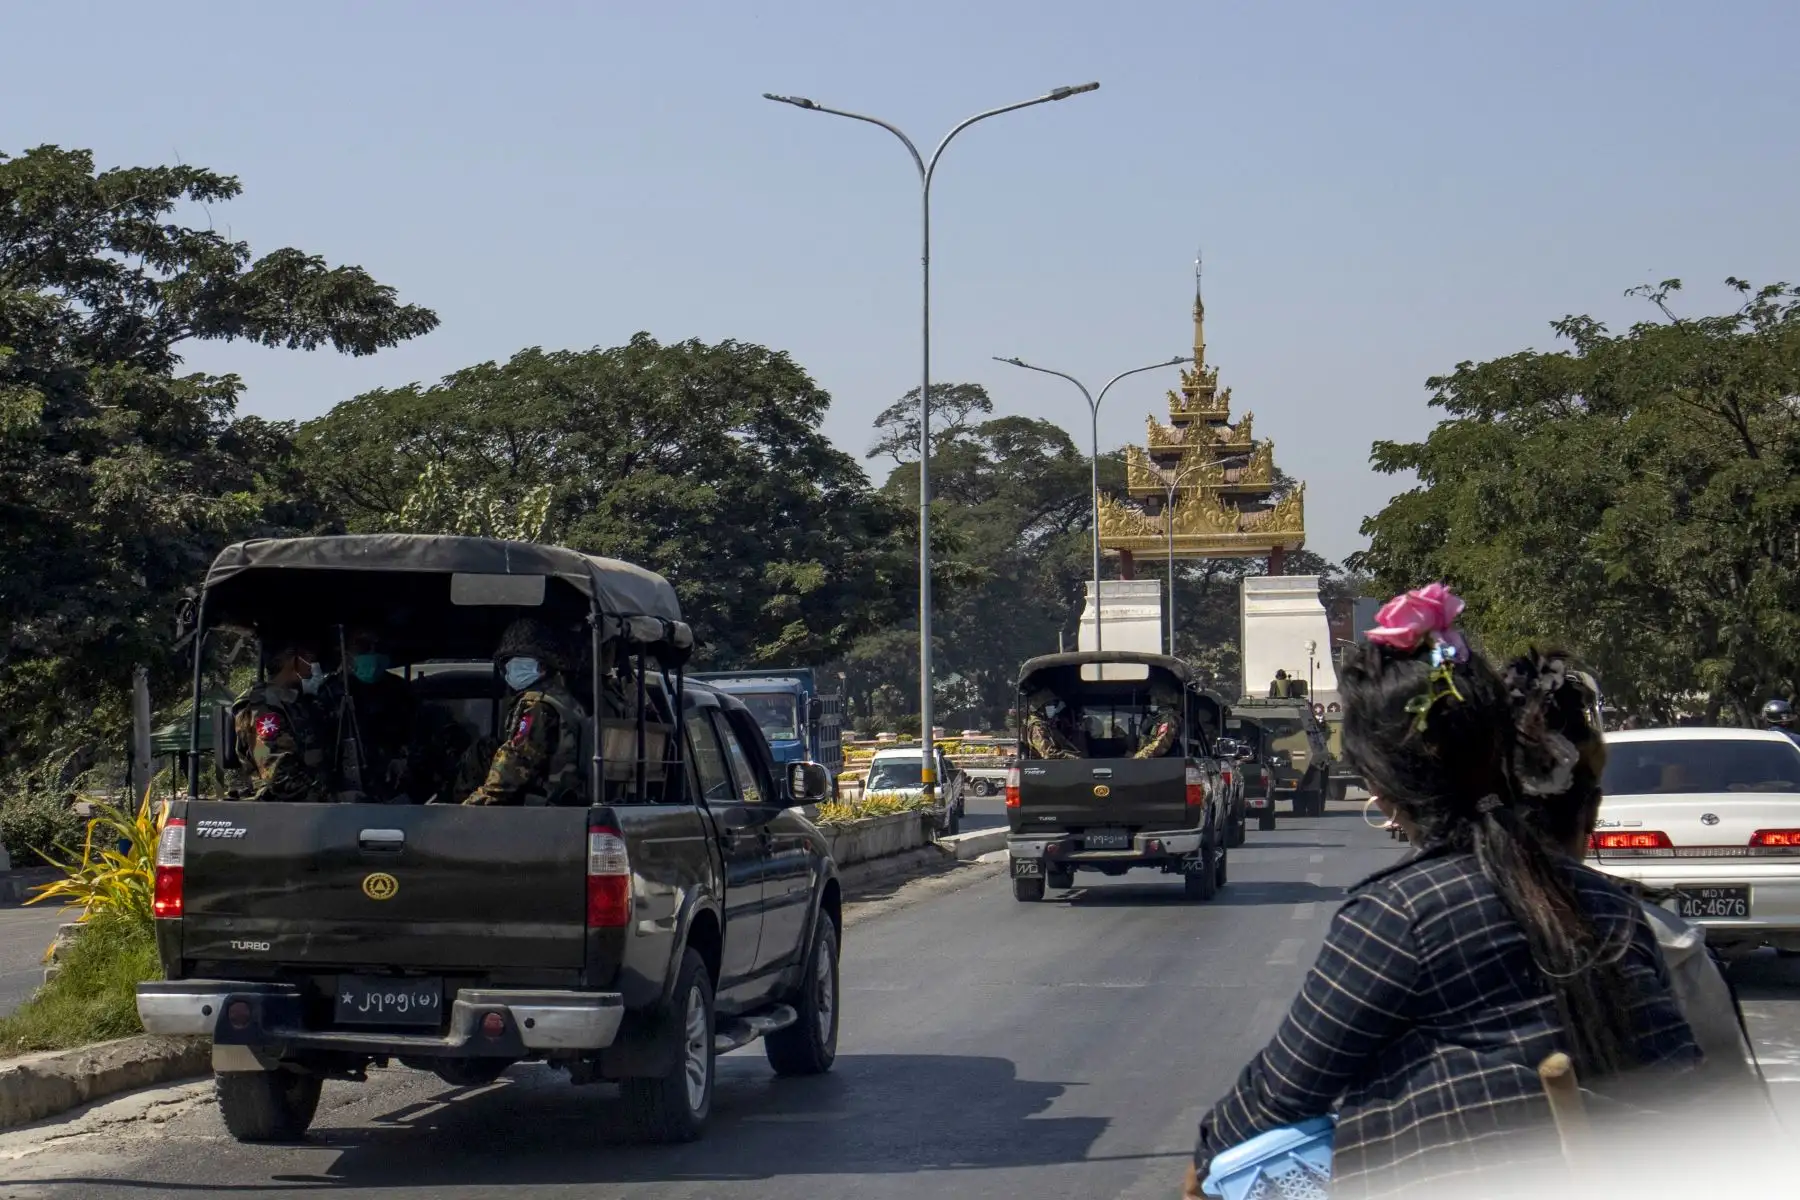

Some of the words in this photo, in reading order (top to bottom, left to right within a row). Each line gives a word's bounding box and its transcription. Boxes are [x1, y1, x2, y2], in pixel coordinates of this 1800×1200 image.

[196, 827, 247, 838] TIGER
[1702, 889, 1725, 898] MDY
[1683, 899, 1746, 916] 4C-4676
[230, 940, 270, 951] TURBO
